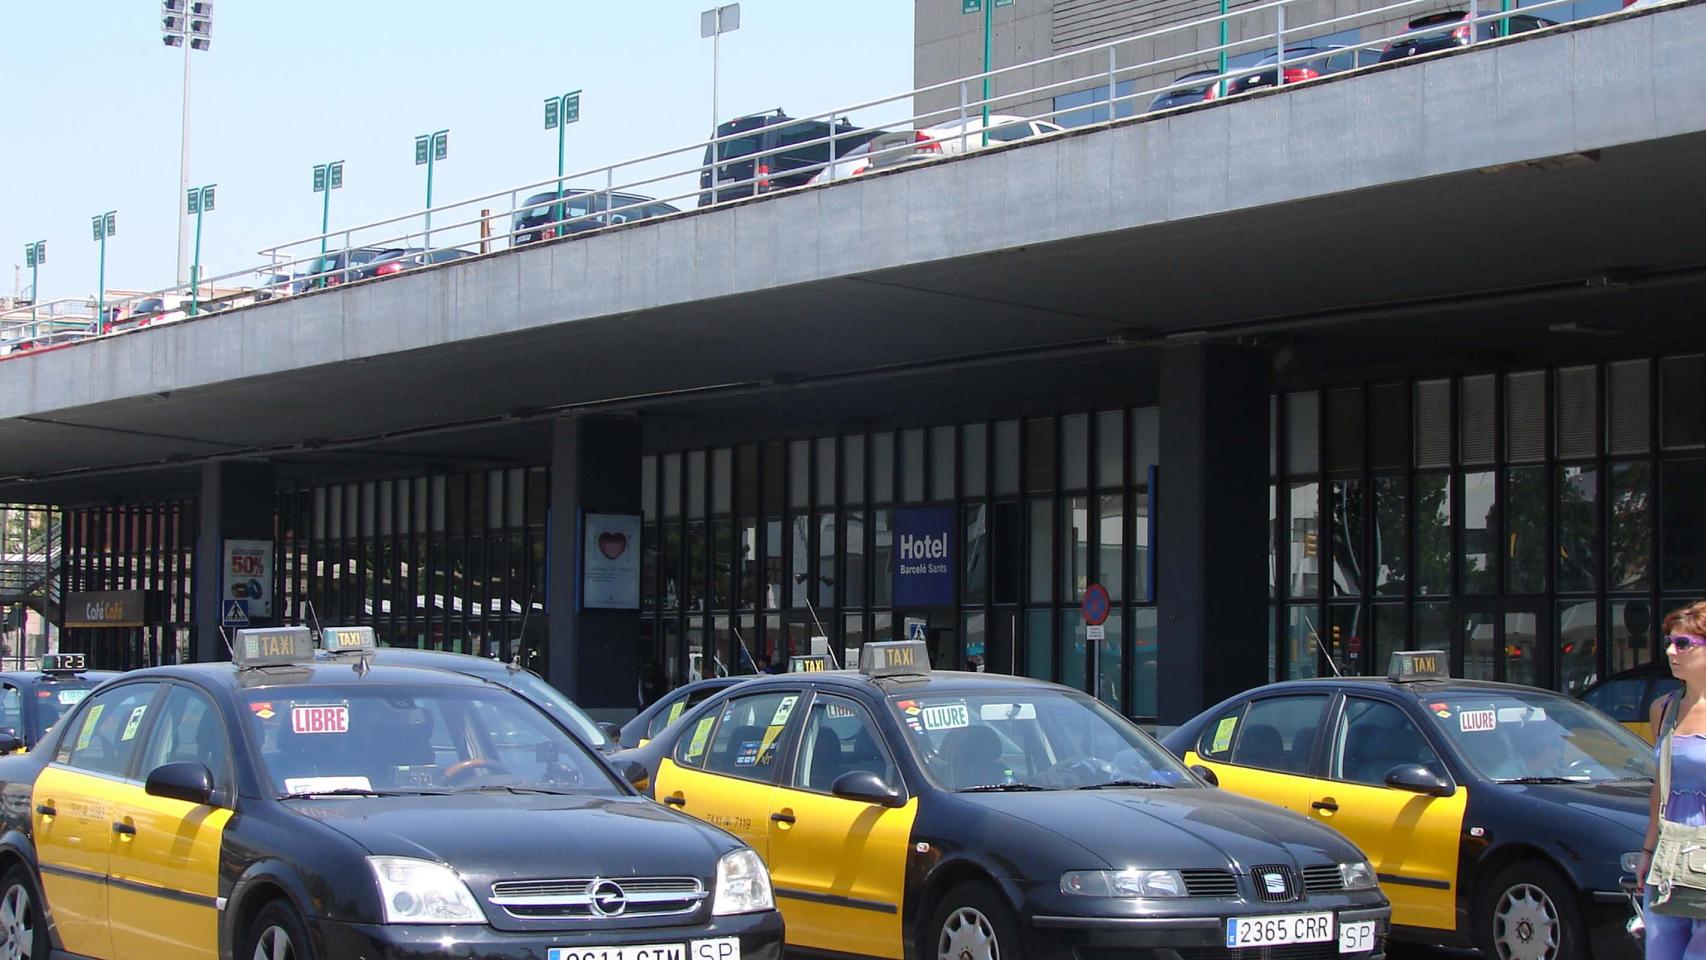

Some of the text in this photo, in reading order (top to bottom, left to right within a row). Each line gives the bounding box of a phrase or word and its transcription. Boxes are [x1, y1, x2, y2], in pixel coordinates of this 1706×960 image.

[900, 532, 948, 560] Hotel
[232, 555, 264, 576] 50%
[928, 563, 948, 574] Sants
[261, 636, 295, 656] TAXI
[338, 631, 360, 646] TAXI
[56, 656, 85, 668] 123
[805, 659, 824, 673] TAXI
[887, 647, 914, 666] TAXI
[1413, 657, 1435, 672] TAXI
[295, 708, 346, 732] LIBRE
[925, 707, 966, 728] LLIURE
[1462, 712, 1493, 730] LLIURE
[706, 814, 751, 830] TAXI 7119
[1240, 917, 1328, 943] 2365 CRR
[1346, 926, 1370, 948] SP
